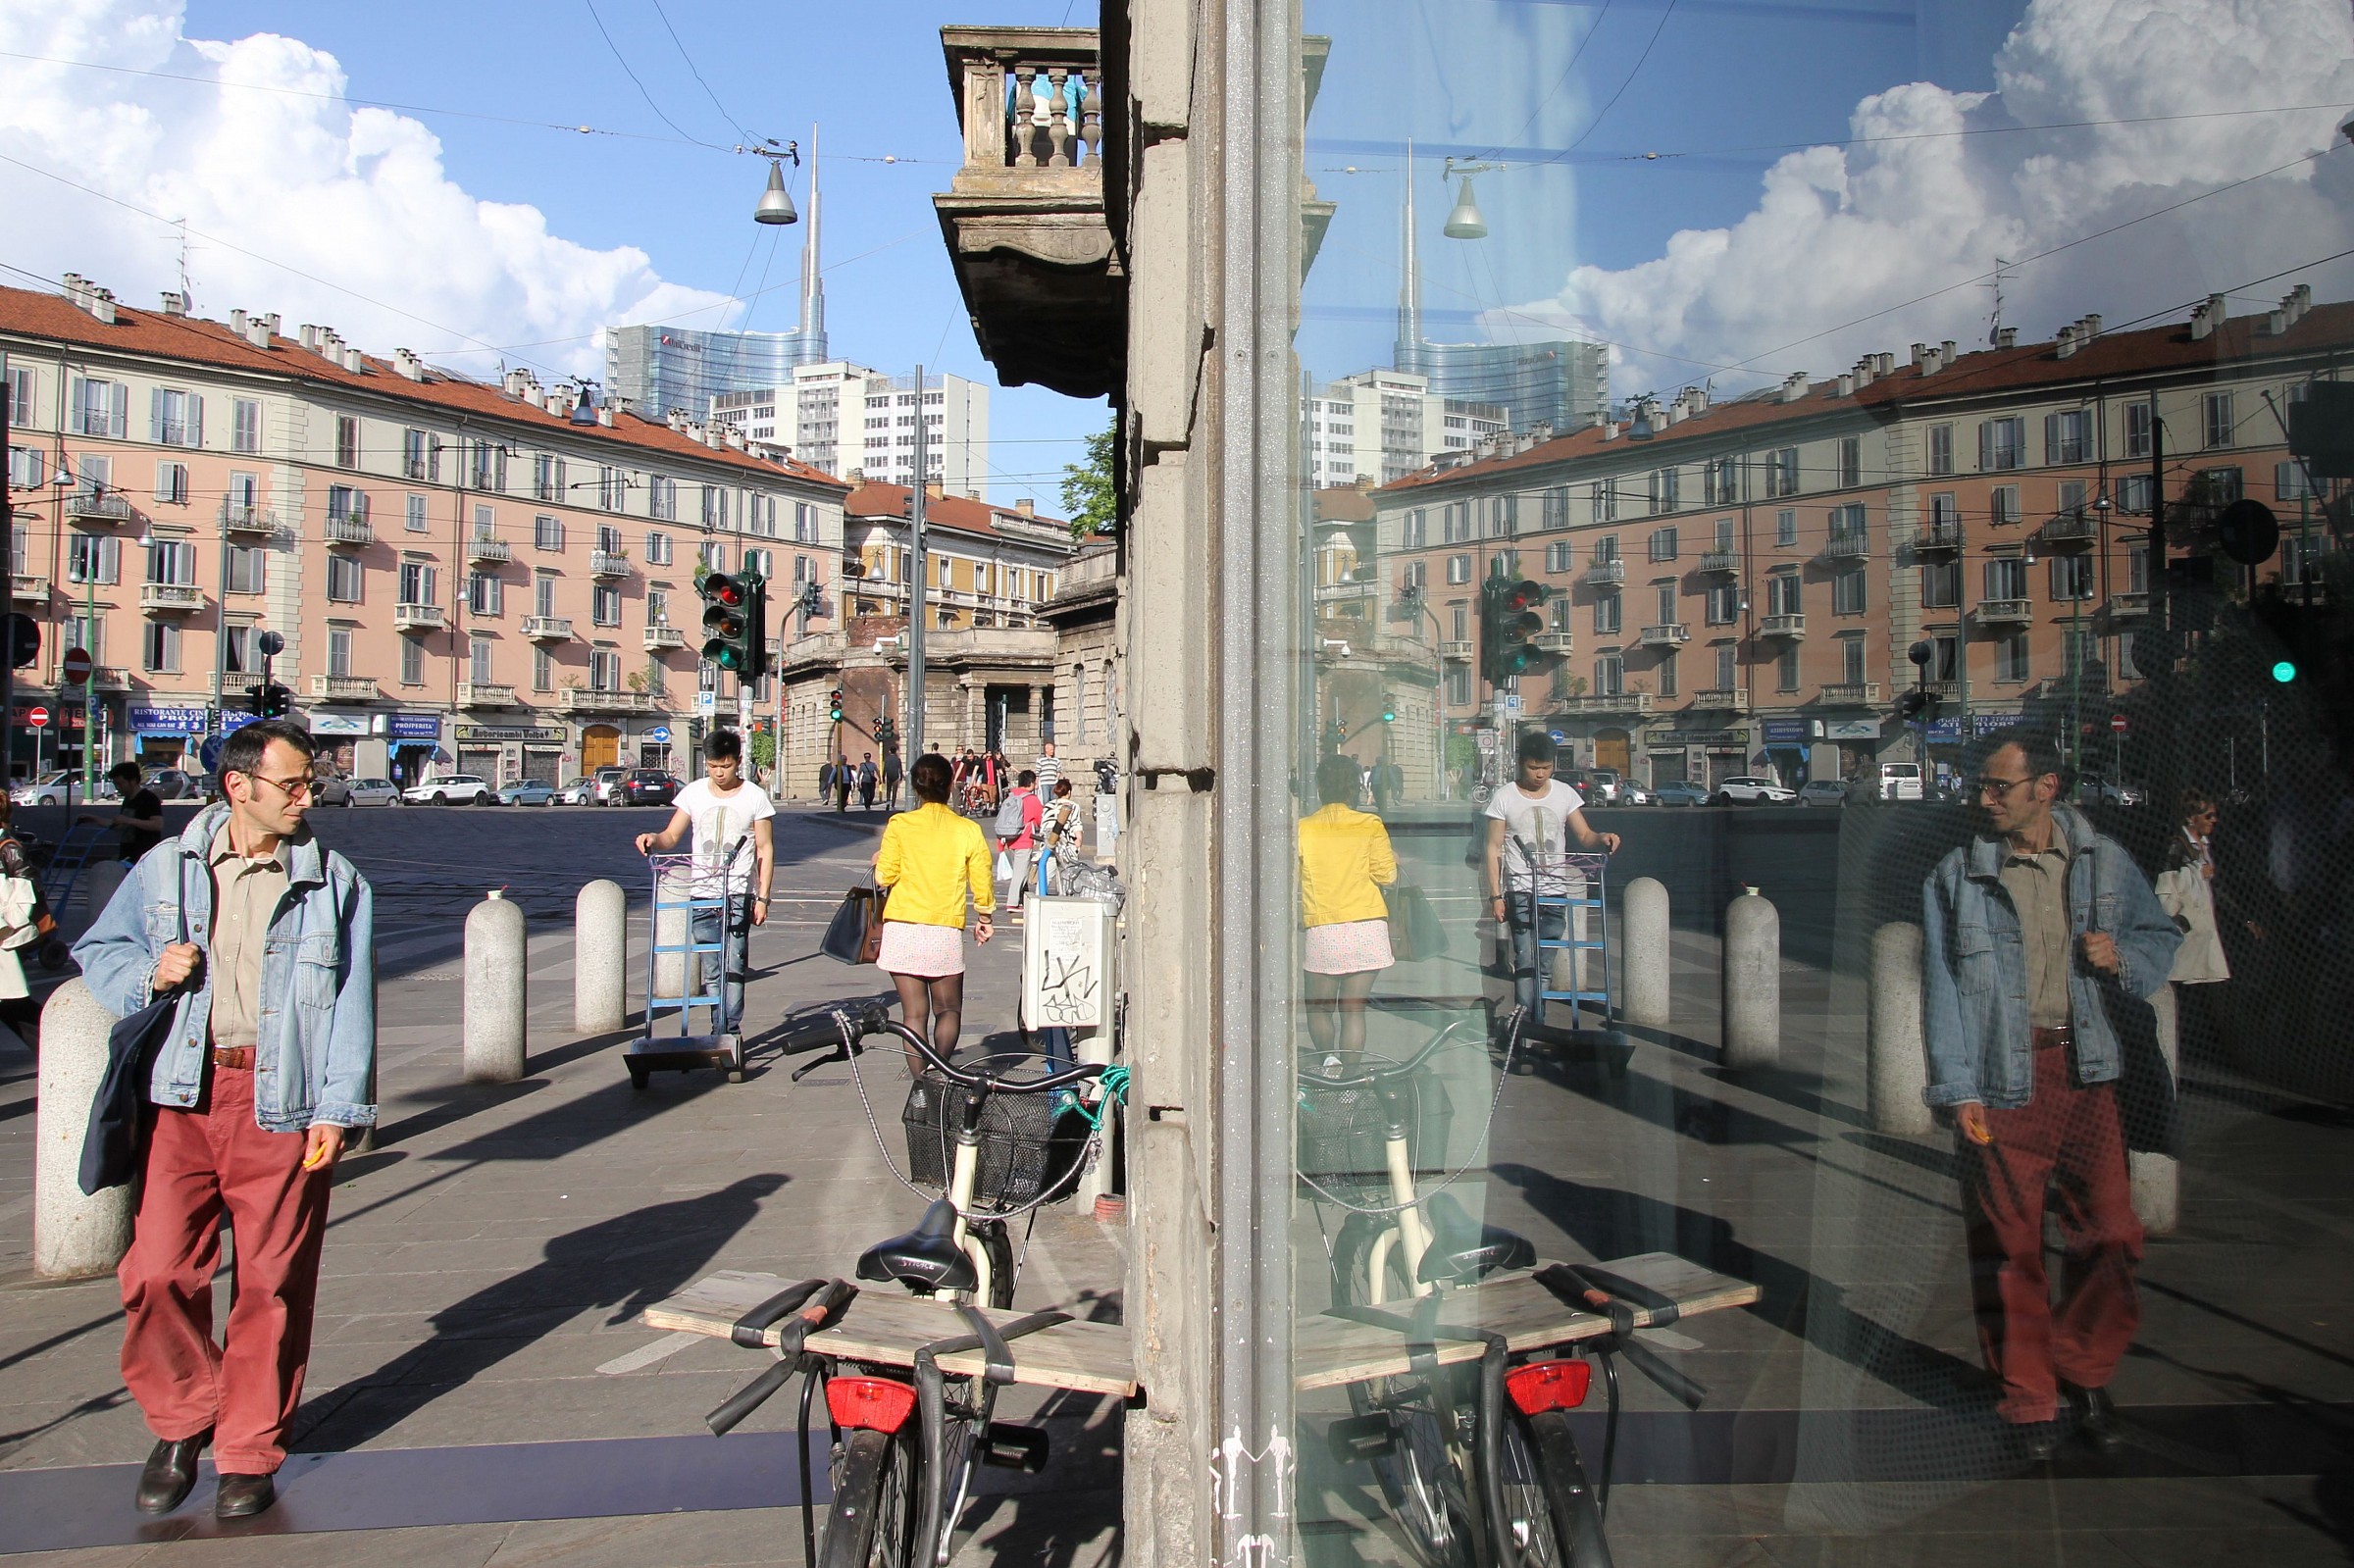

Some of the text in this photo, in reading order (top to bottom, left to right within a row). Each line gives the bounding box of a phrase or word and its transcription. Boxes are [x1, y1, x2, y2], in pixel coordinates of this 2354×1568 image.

[668, 337, 701, 353] UniCredit
[702, 694, 711, 704] P
[133, 708, 186, 717] RISTORANTE
[472, 728, 544, 739] Autoricambi Volta
